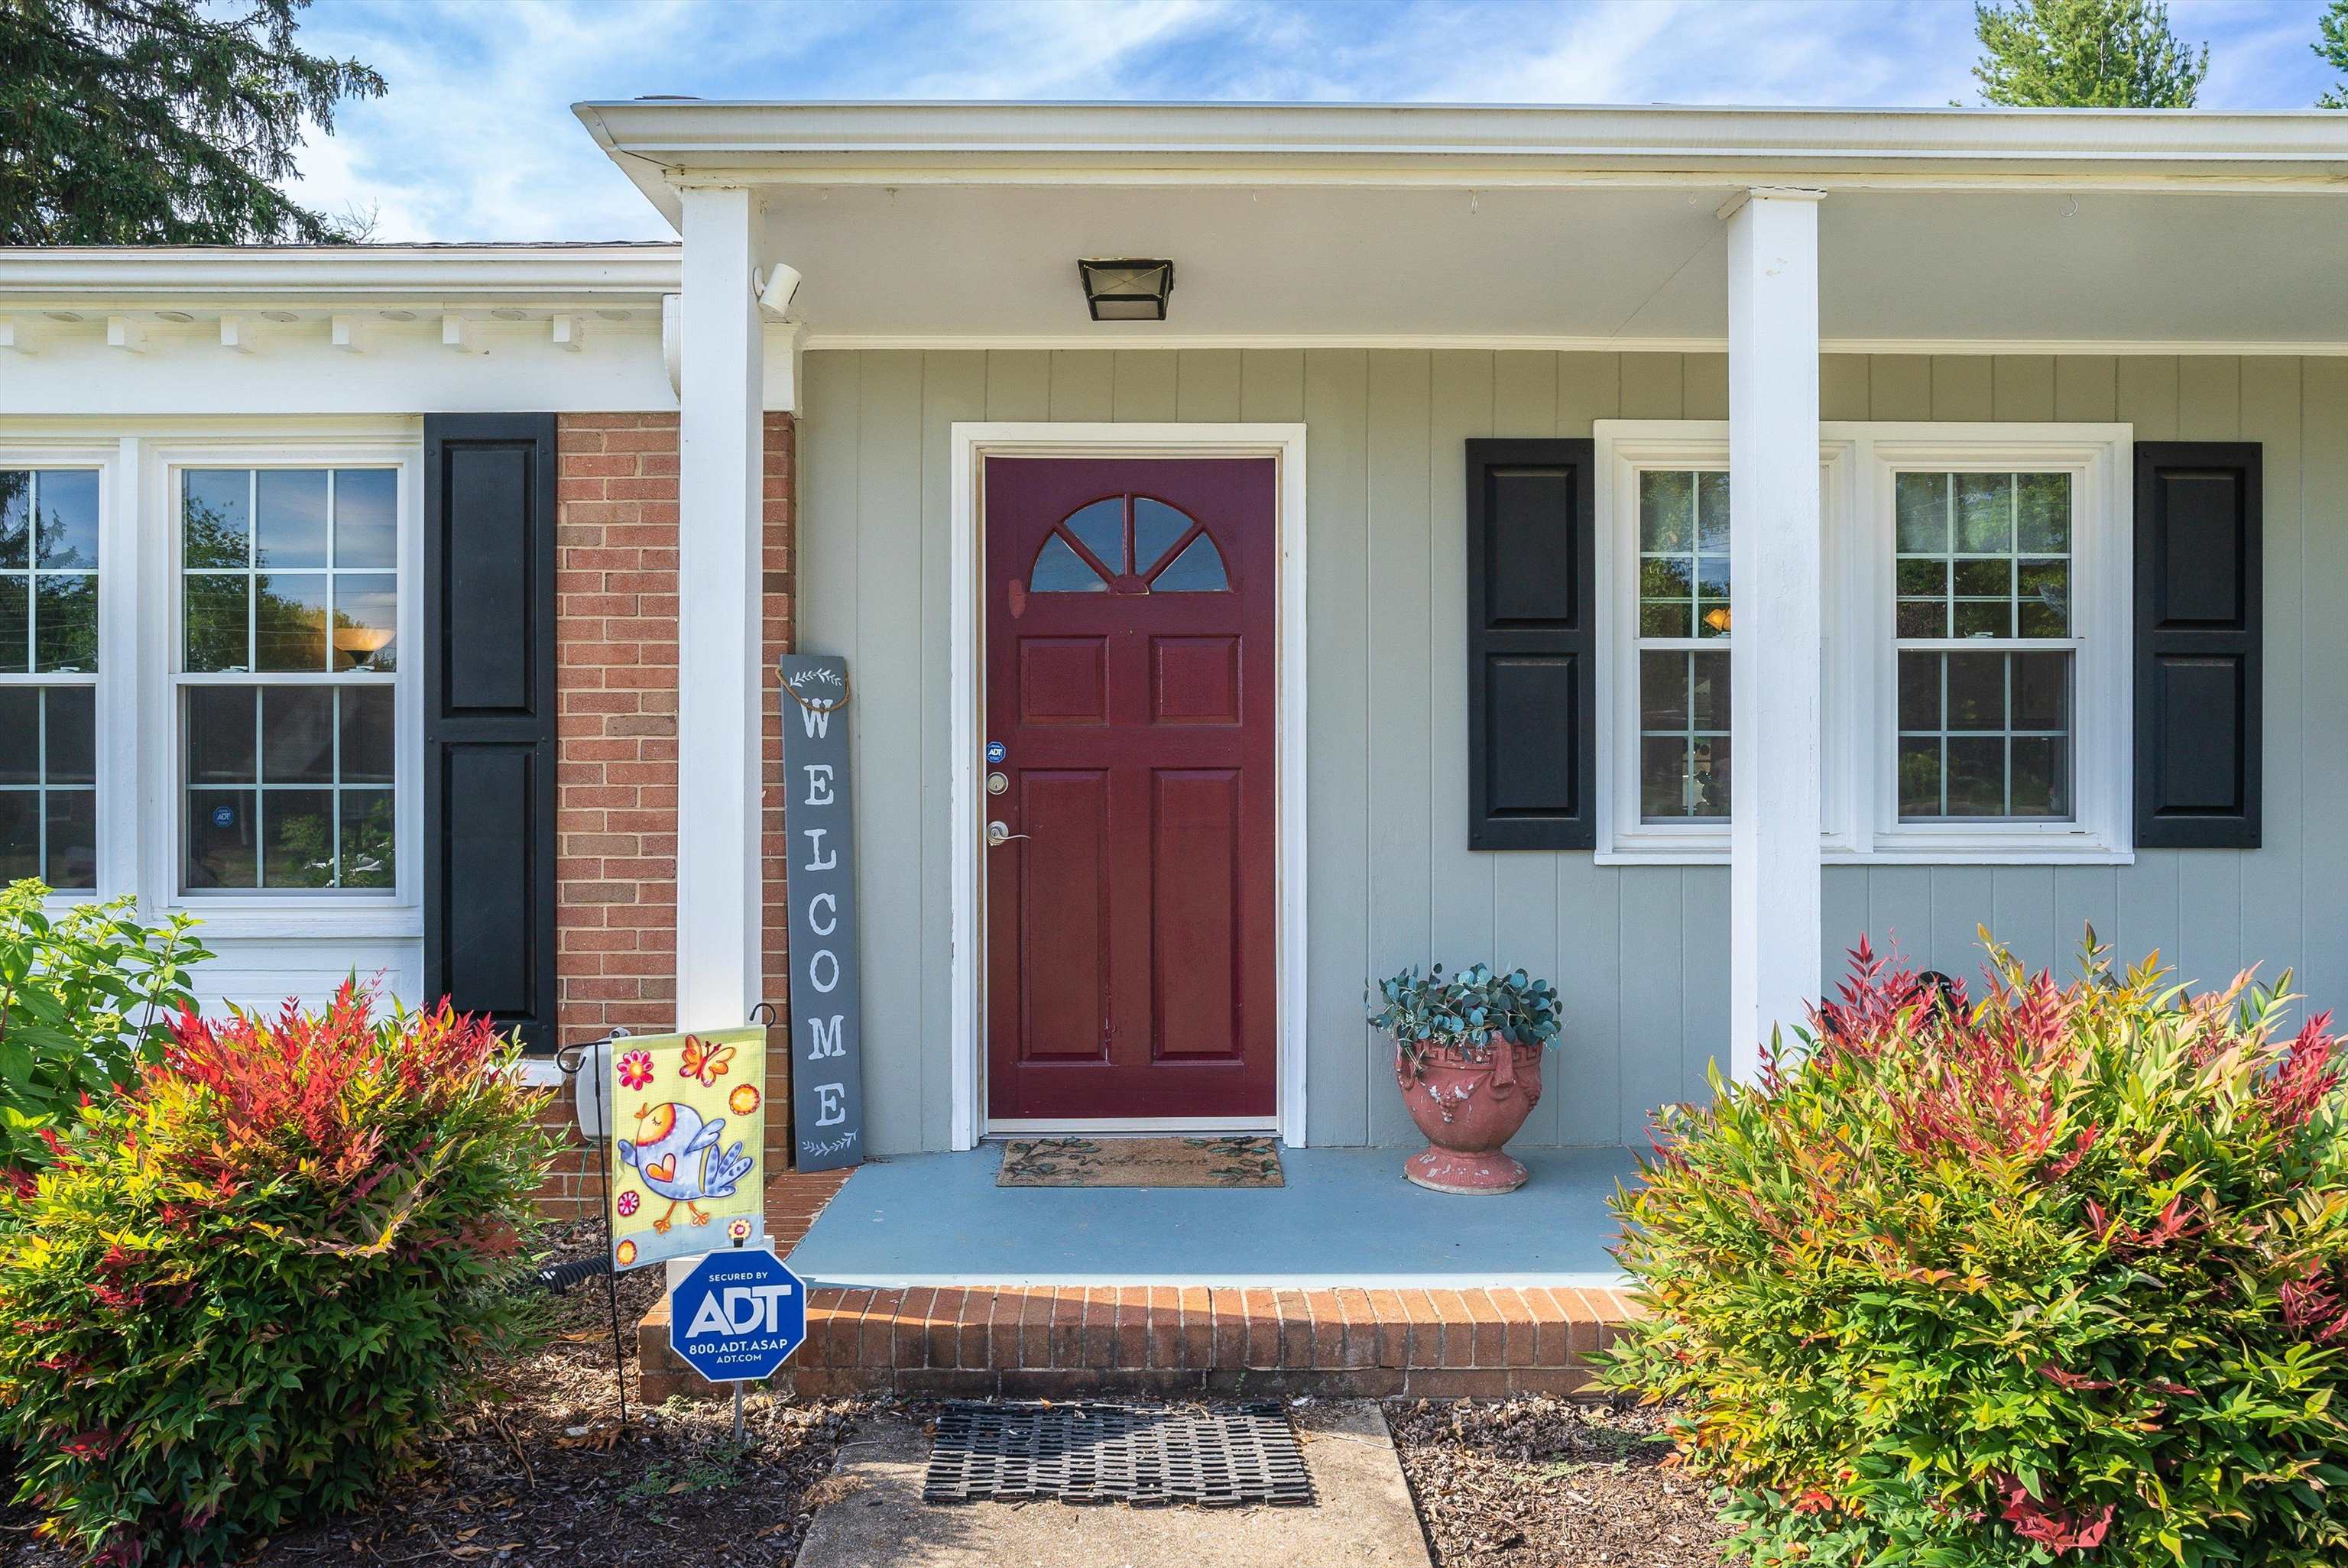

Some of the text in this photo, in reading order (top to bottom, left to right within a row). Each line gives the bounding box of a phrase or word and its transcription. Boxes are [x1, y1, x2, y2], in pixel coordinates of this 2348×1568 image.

[988, 748, 1002, 756] ADT
[216, 812, 230, 821] ADT
[799, 697, 846, 1126] WELCOME
[709, 1272, 768, 1282] SECURED BY
[685, 1285, 792, 1338] ADT
[689, 1339, 788, 1355] 800.ADT.ASAP
[716, 1353, 762, 1364] ADT.COM
